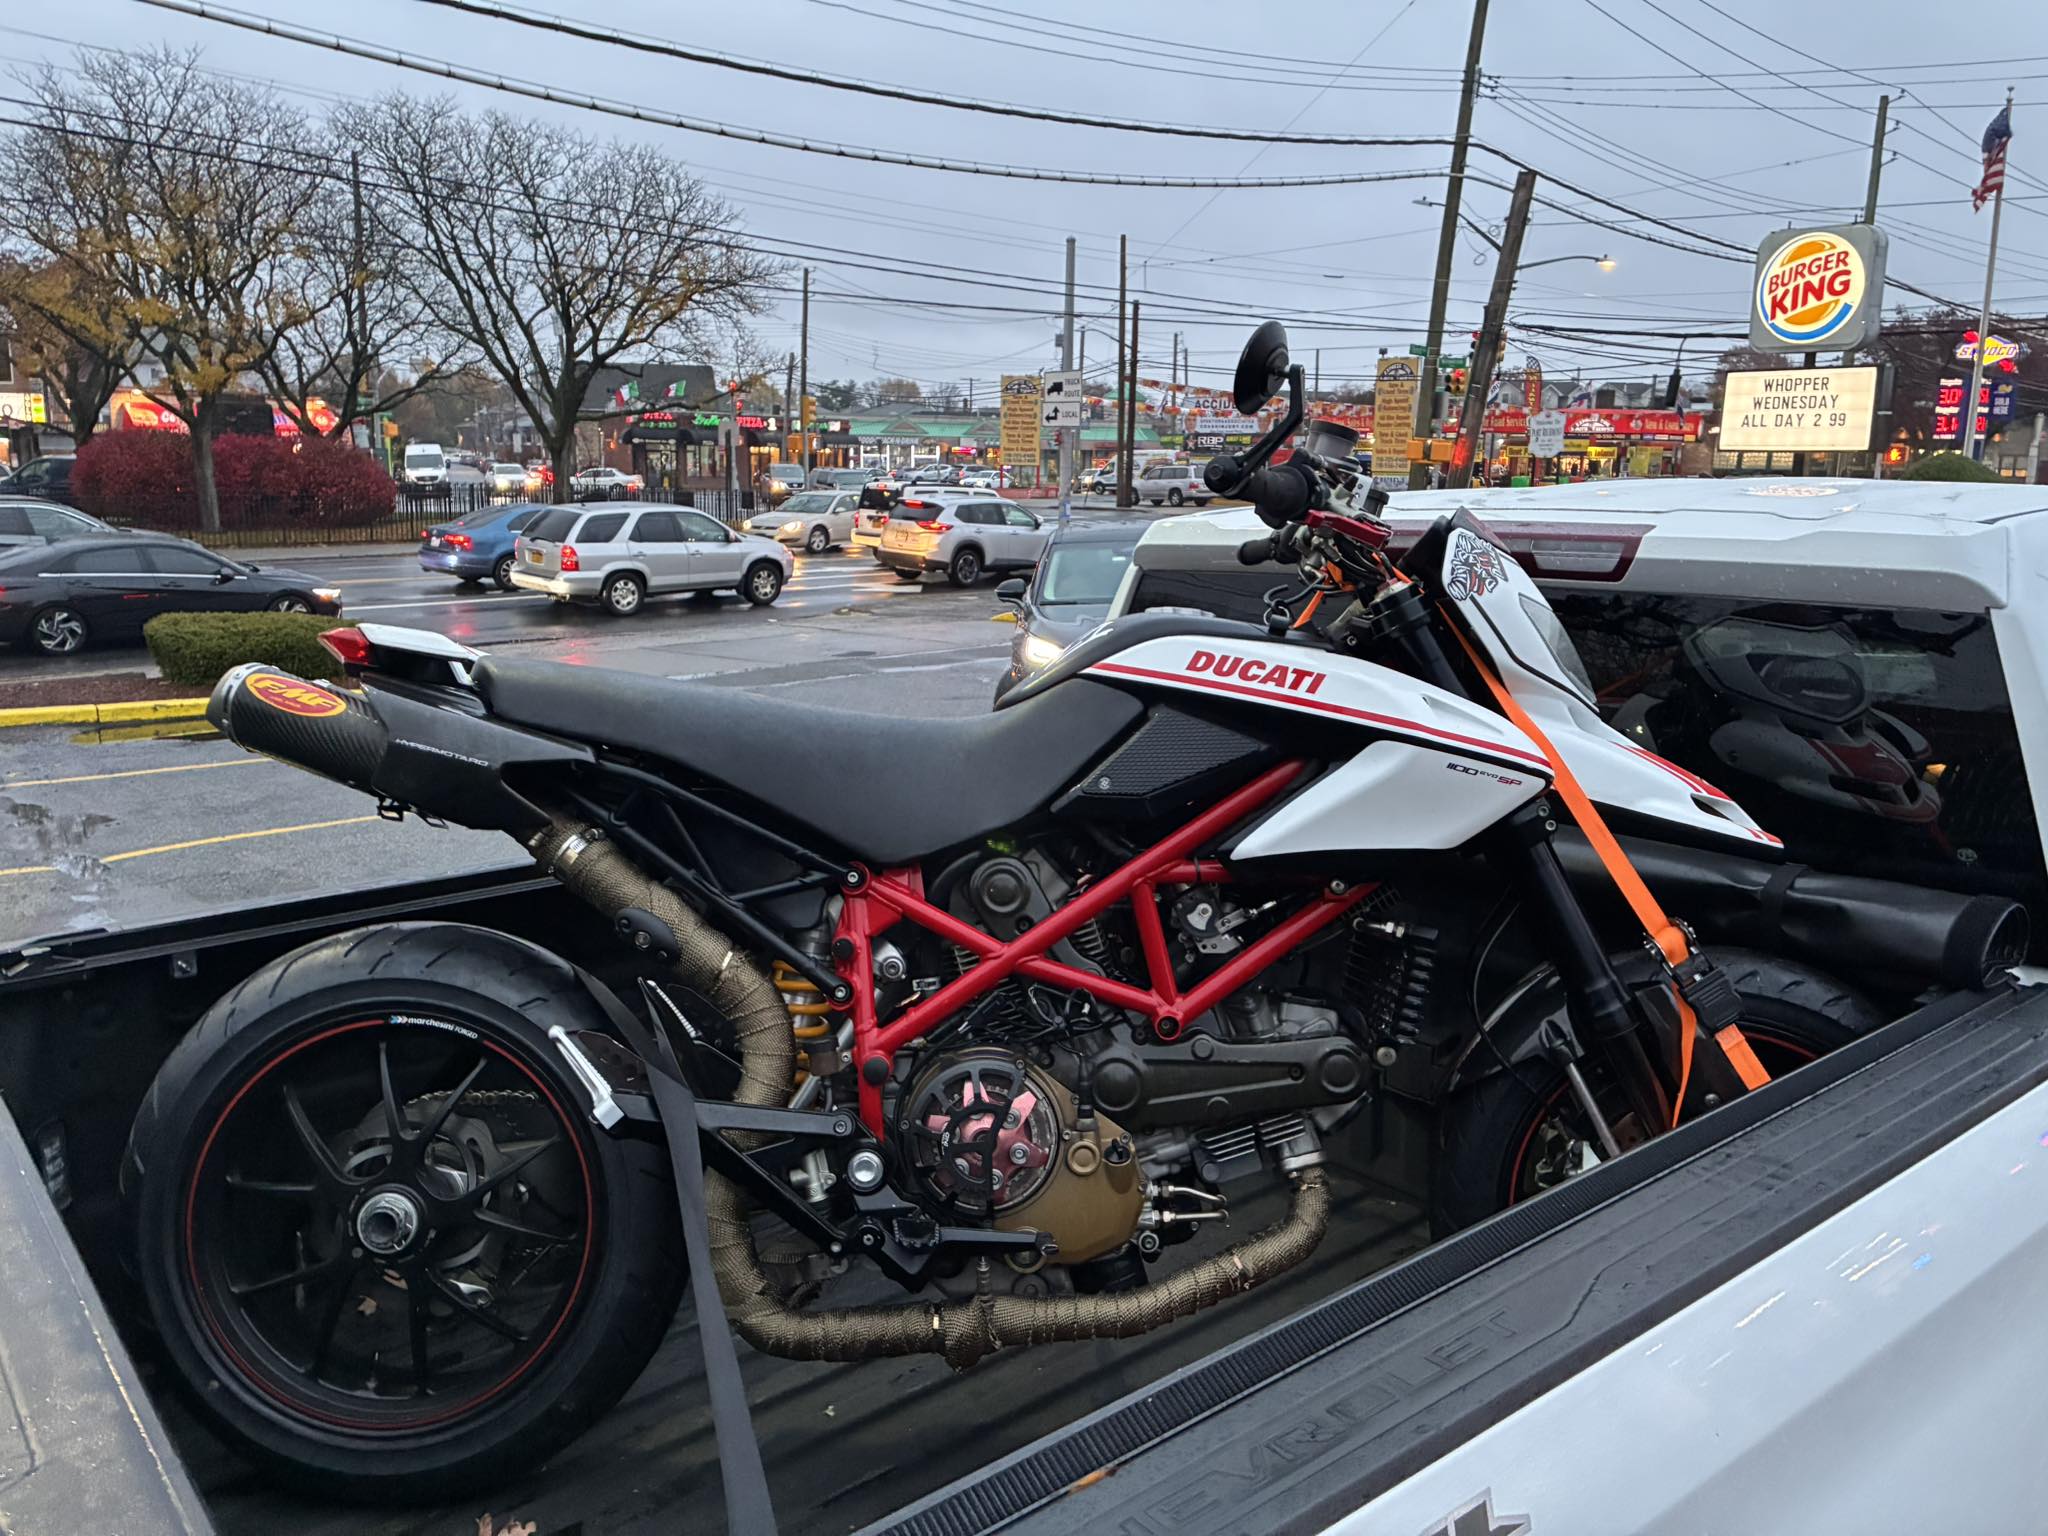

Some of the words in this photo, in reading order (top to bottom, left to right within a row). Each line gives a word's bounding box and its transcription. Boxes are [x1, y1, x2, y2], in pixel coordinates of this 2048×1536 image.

[1768, 251, 1849, 295] BURGER
[1770, 270, 1851, 320] KING
[1958, 345, 2017, 357] SOCO
[1064, 378, 1080, 386] TRUCK
[1763, 377, 1829, 391] WHOPPER
[1064, 390, 1080, 398] ROUTE
[1195, 399, 1237, 410] ACCID
[1753, 395, 1839, 410] WEDNESDAY
[736, 416, 764, 428] PIZZA
[1741, 413, 1767, 428] ALL
[1774, 413, 1804, 428] DAY
[1813, 413, 1822, 427] 2
[1828, 413, 1847, 427] 99
[1198, 436, 1224, 445] RBP
[1185, 650, 1328, 695] DUCATI
[253, 680, 341, 708] FMF
[395, 738, 489, 767] HYPERMOTARD
[1446, 763, 1479, 776] 1100
[1497, 775, 1522, 786] SP
[408, 1016, 454, 1031] marchesini
[454, 1026, 478, 1039] FORGED
